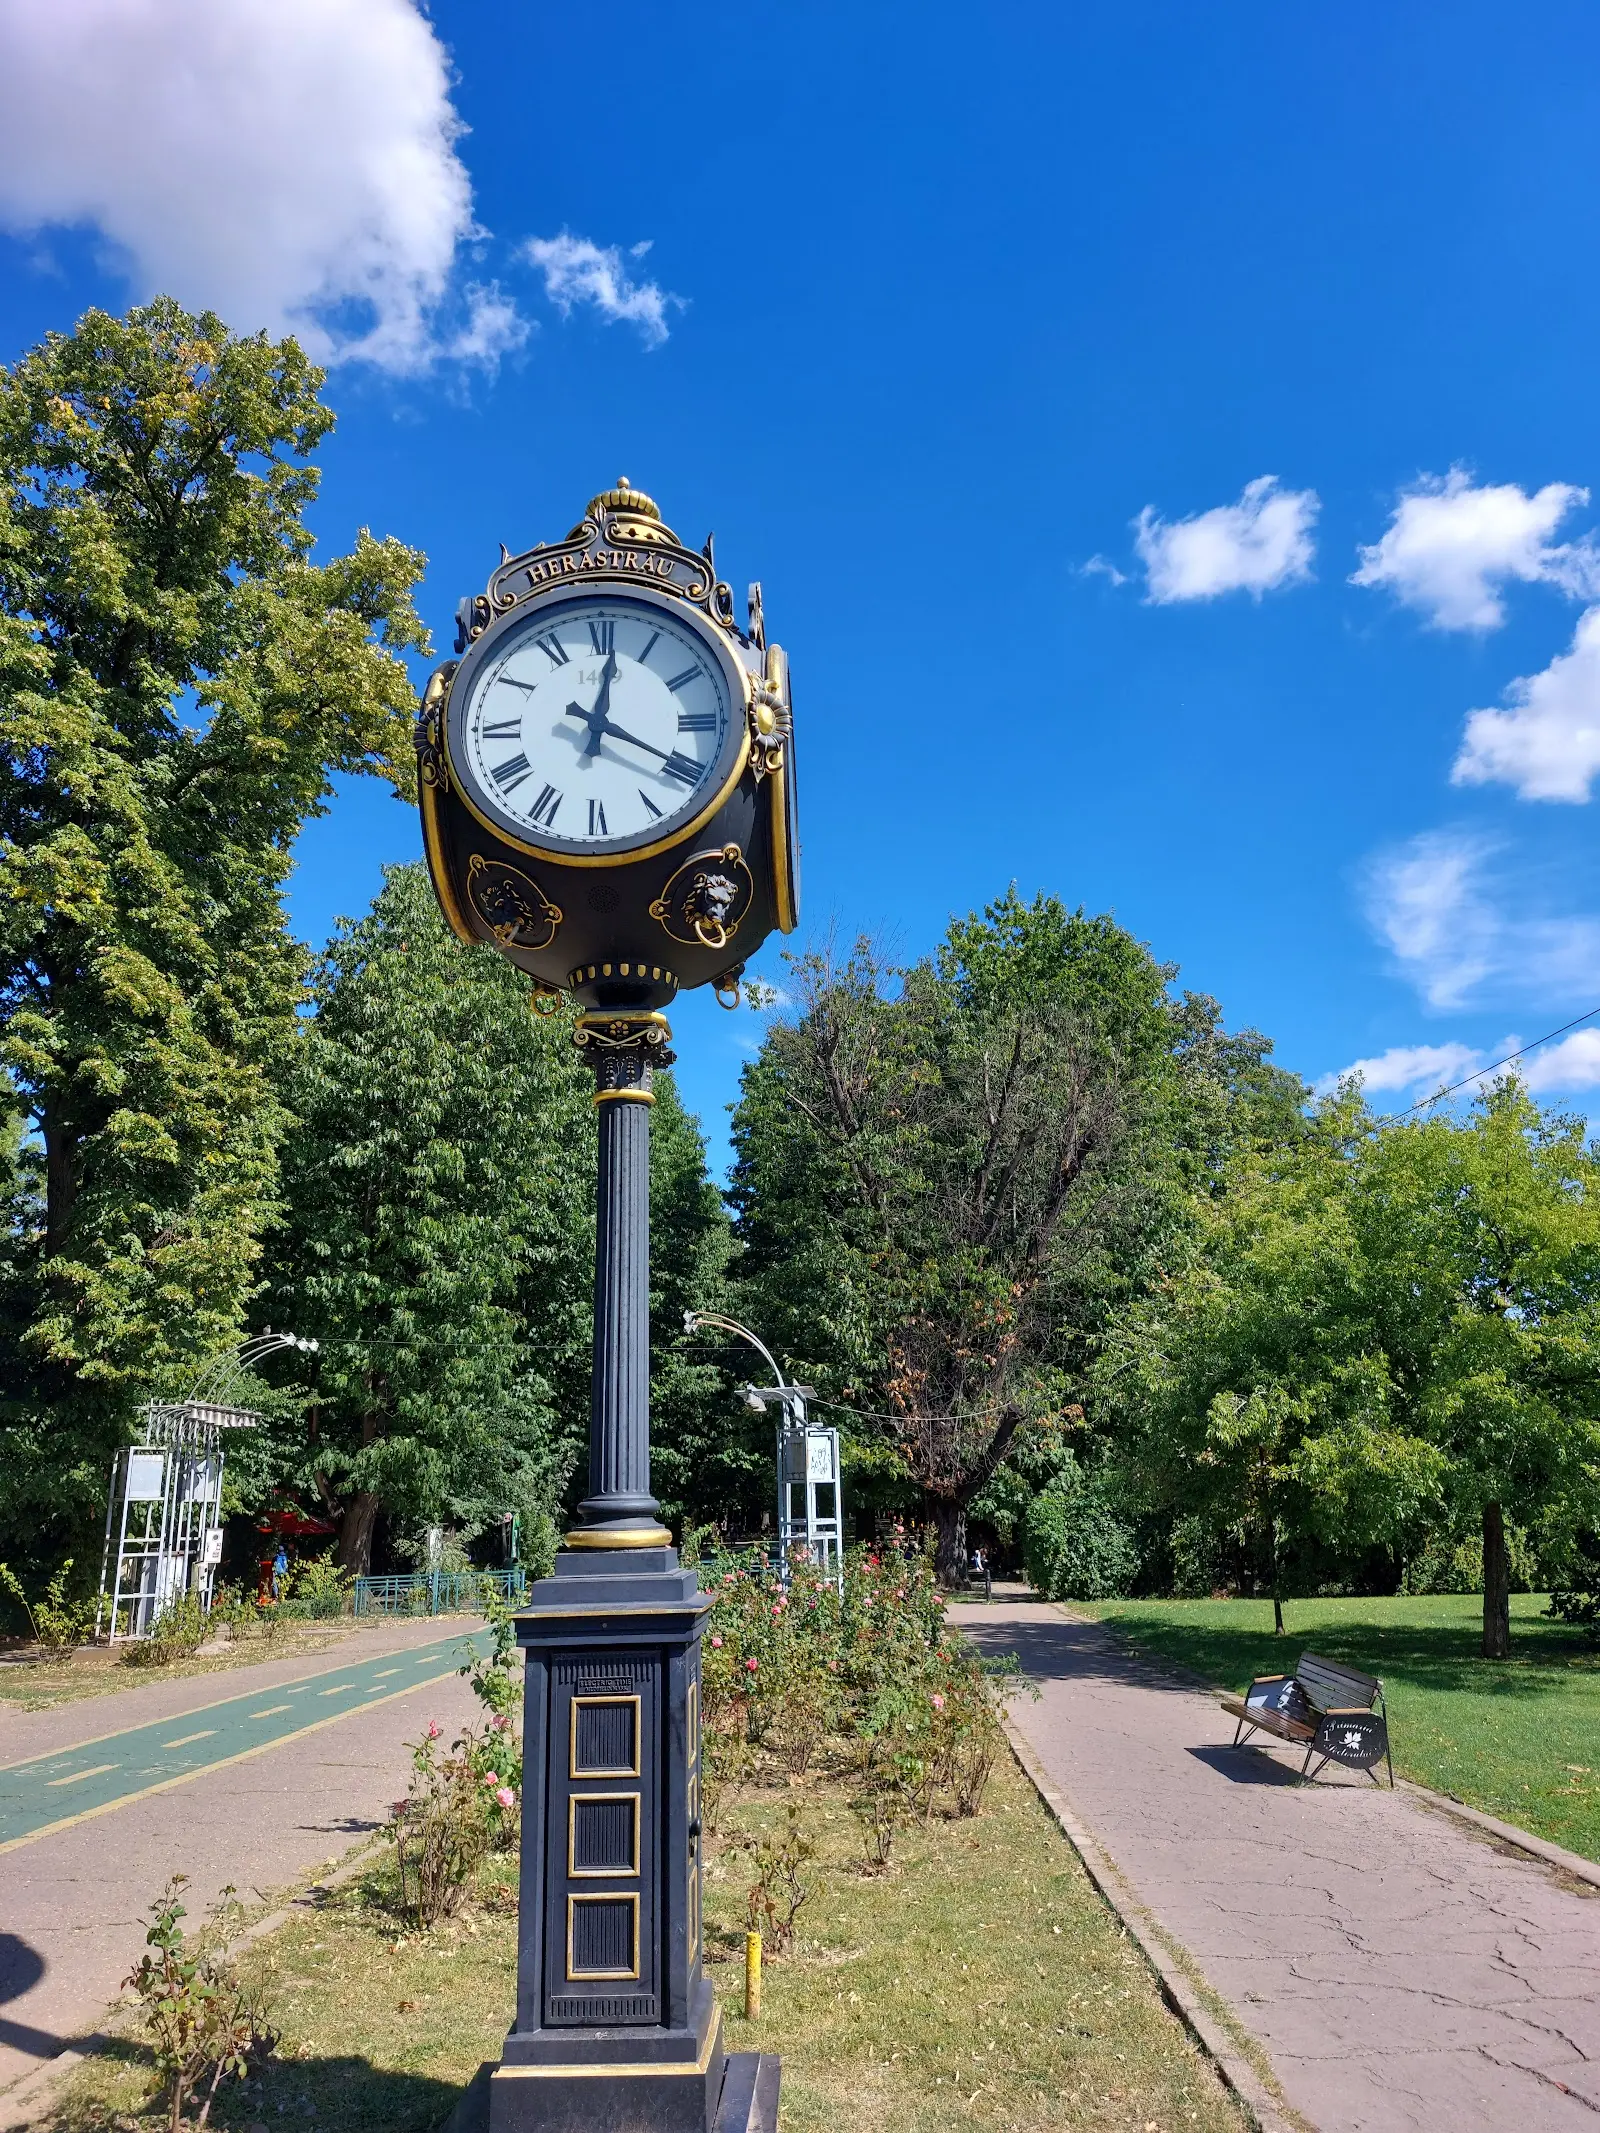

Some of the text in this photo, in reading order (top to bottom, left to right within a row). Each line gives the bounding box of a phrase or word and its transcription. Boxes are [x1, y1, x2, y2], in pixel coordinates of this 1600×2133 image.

[527, 548, 675, 582] HERĂSTRĂU
[584, 620, 619, 657] XII
[493, 665, 539, 703] X
[577, 669, 623, 686] 149
[677, 708, 716, 736] III
[657, 745, 709, 793] III
[1323, 1730, 1331, 1742] 1
